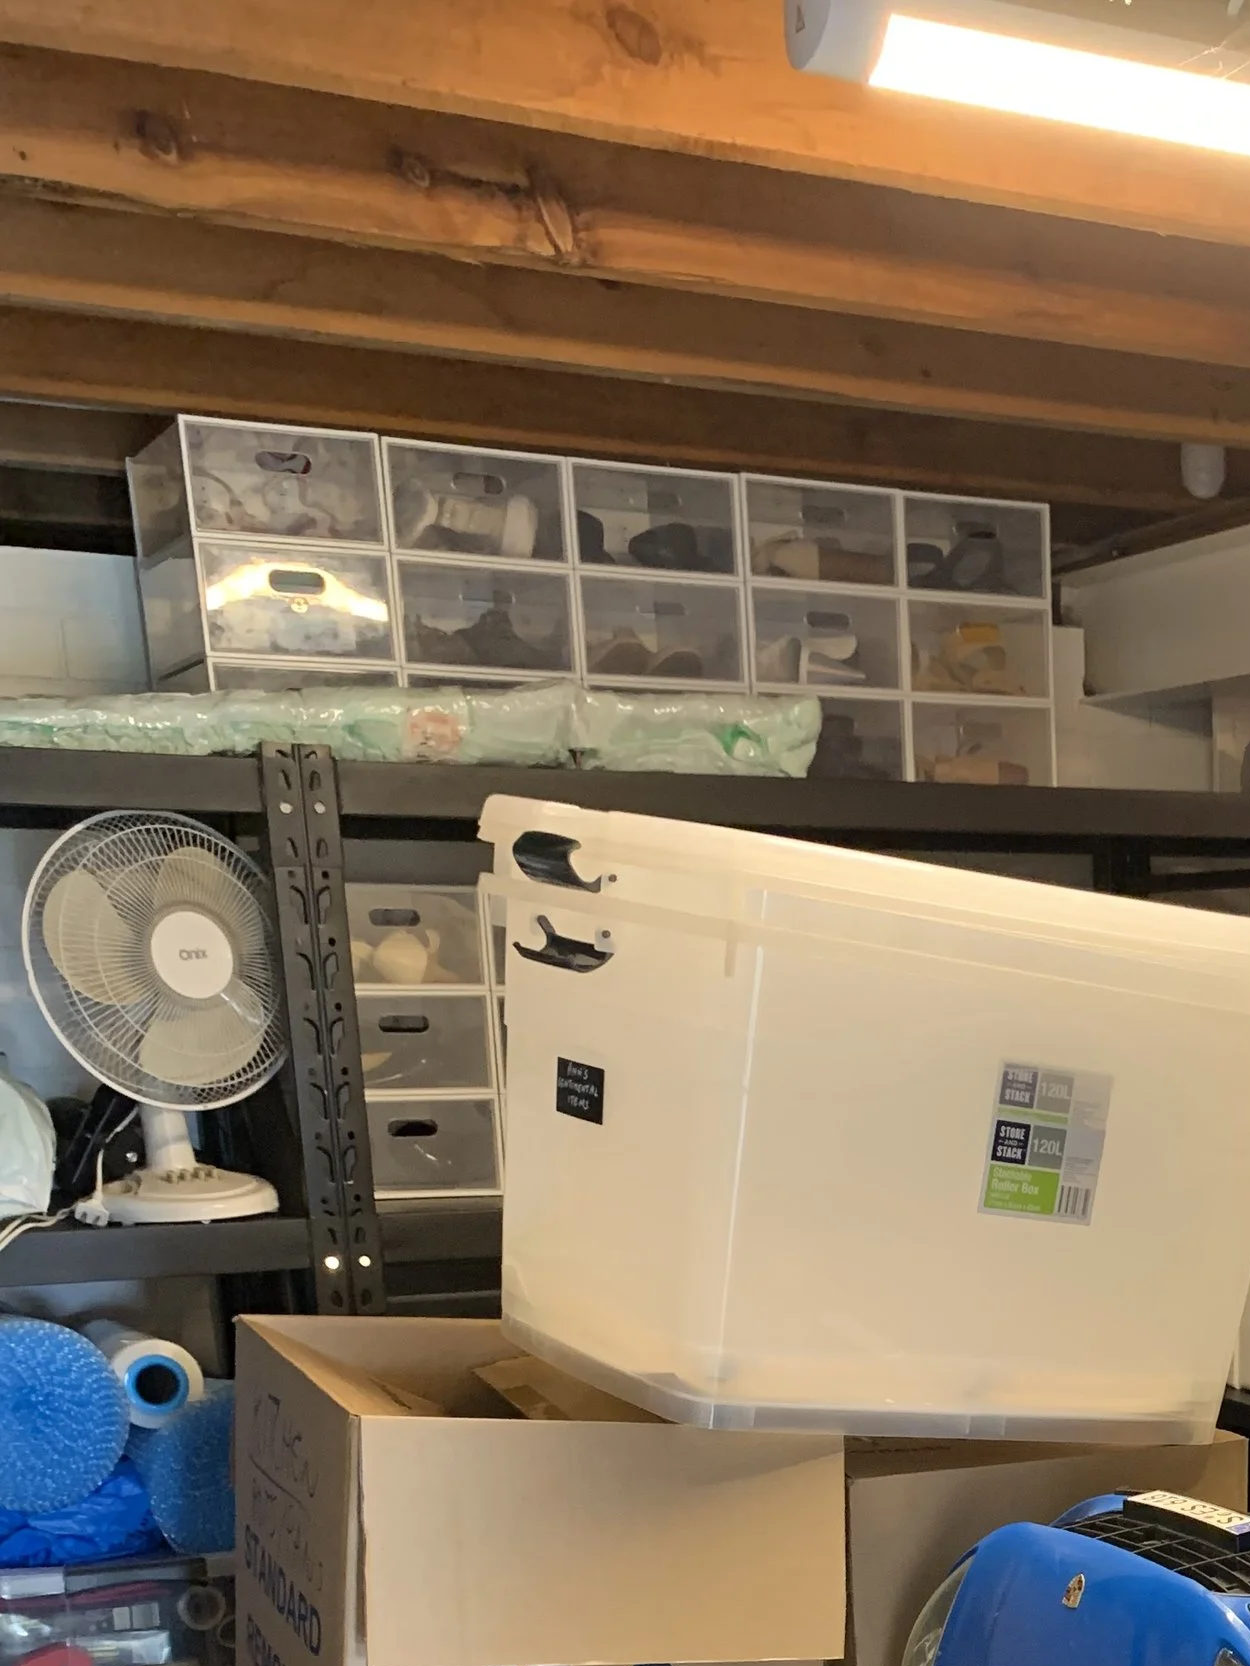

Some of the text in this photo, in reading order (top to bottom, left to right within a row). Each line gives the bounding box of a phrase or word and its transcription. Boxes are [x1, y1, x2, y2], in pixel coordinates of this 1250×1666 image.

[1004, 1088, 1031, 1104] STACK
[1040, 1081, 1071, 1100] 120L
[999, 1125, 1026, 1140] STORE
[996, 1145, 1023, 1160] STACK
[1032, 1138, 1064, 1156] 120L
[244, 1524, 322, 1657] STANDARD
